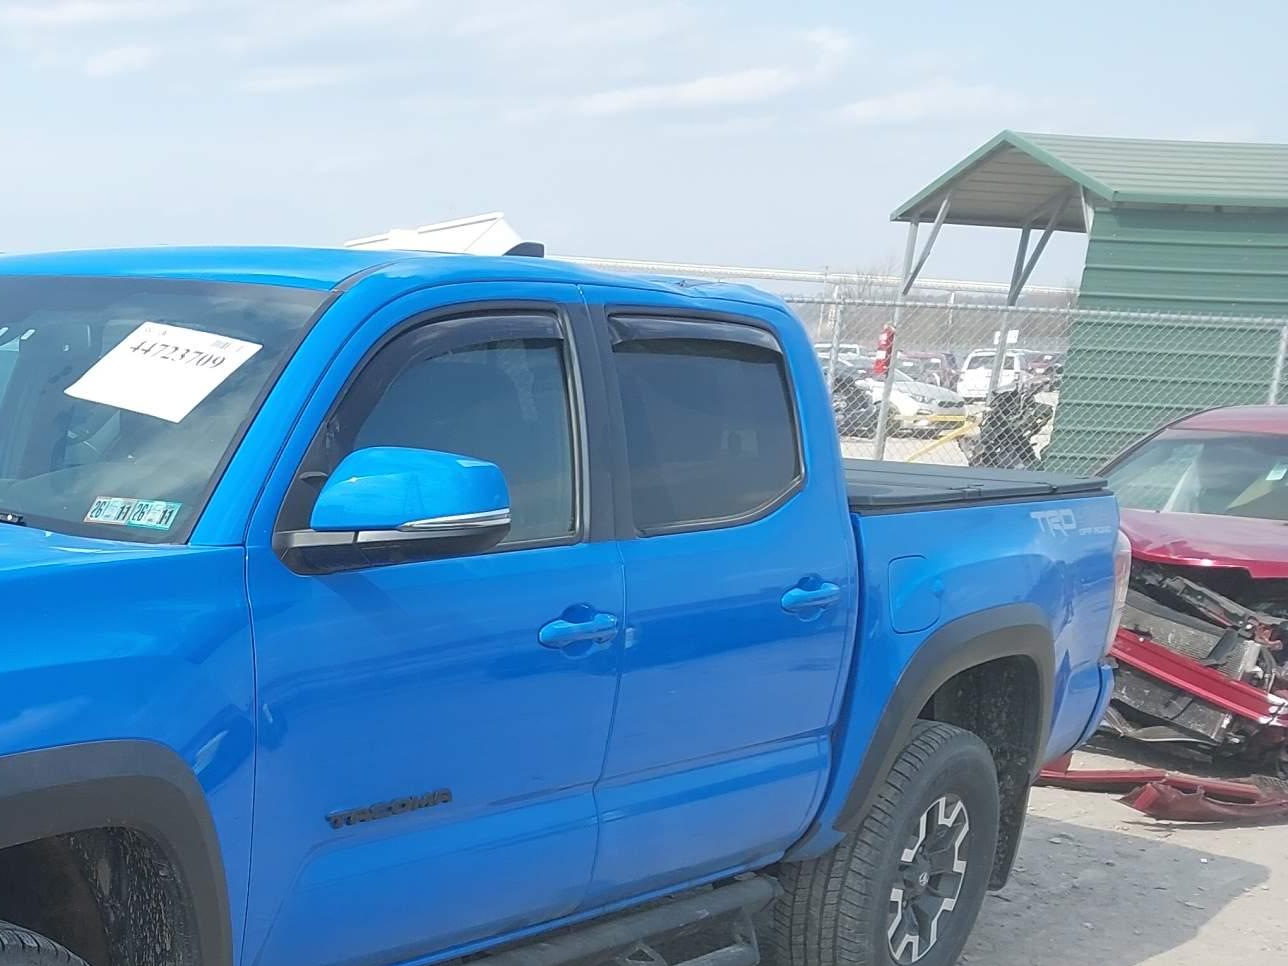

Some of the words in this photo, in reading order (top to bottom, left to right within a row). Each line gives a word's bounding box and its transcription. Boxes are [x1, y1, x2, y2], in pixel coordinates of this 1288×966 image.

[130, 340, 226, 369] 44723709
[1030, 509, 1077, 537] TRD
[325, 787, 453, 829] TACOMA
